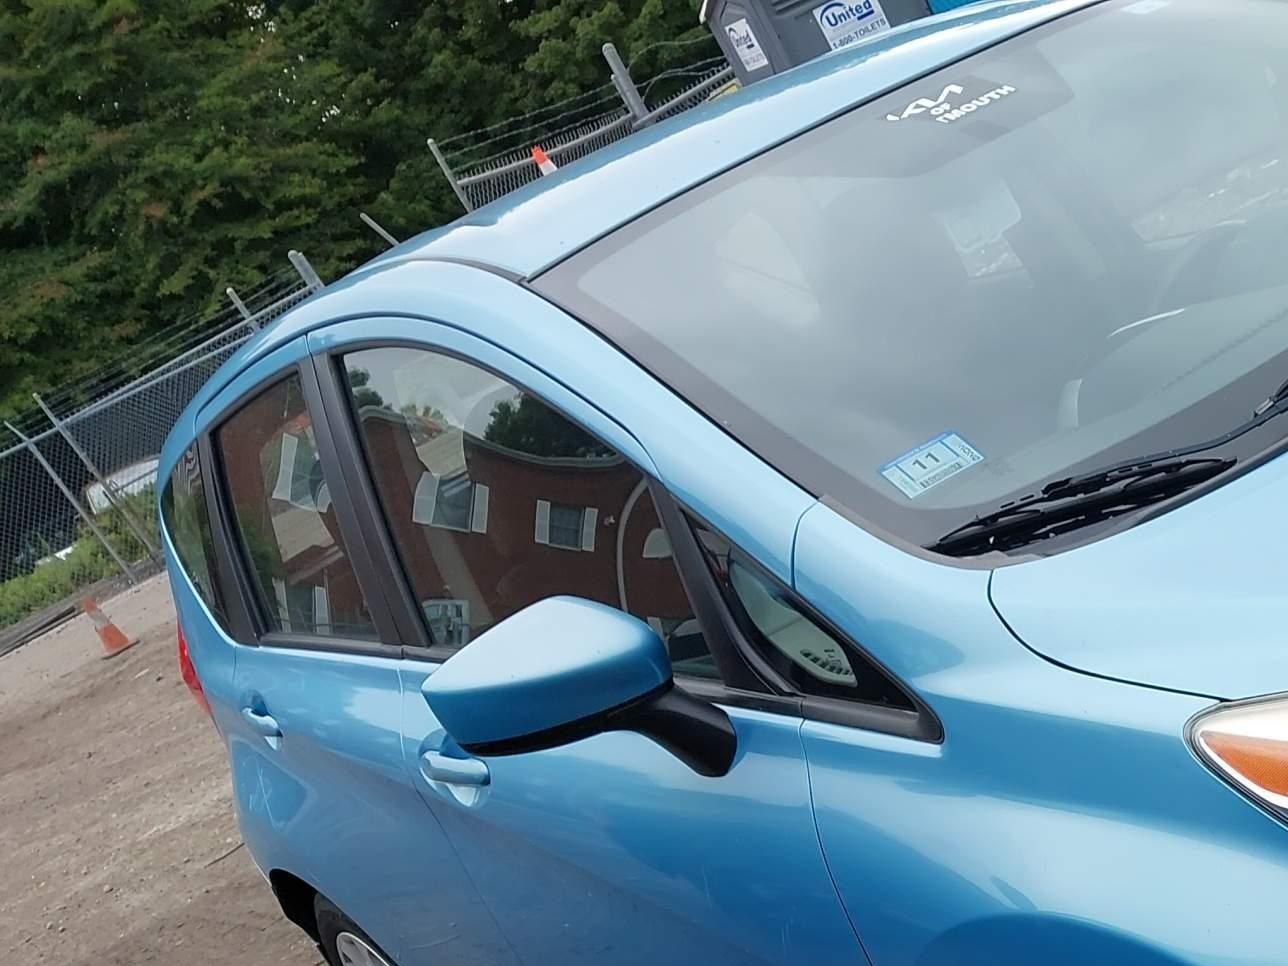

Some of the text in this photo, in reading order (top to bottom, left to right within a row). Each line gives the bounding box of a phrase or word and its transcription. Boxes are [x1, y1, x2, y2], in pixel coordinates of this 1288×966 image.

[825, 0, 873, 27] United
[930, 102, 950, 115] OF
[912, 452, 941, 470] 11
